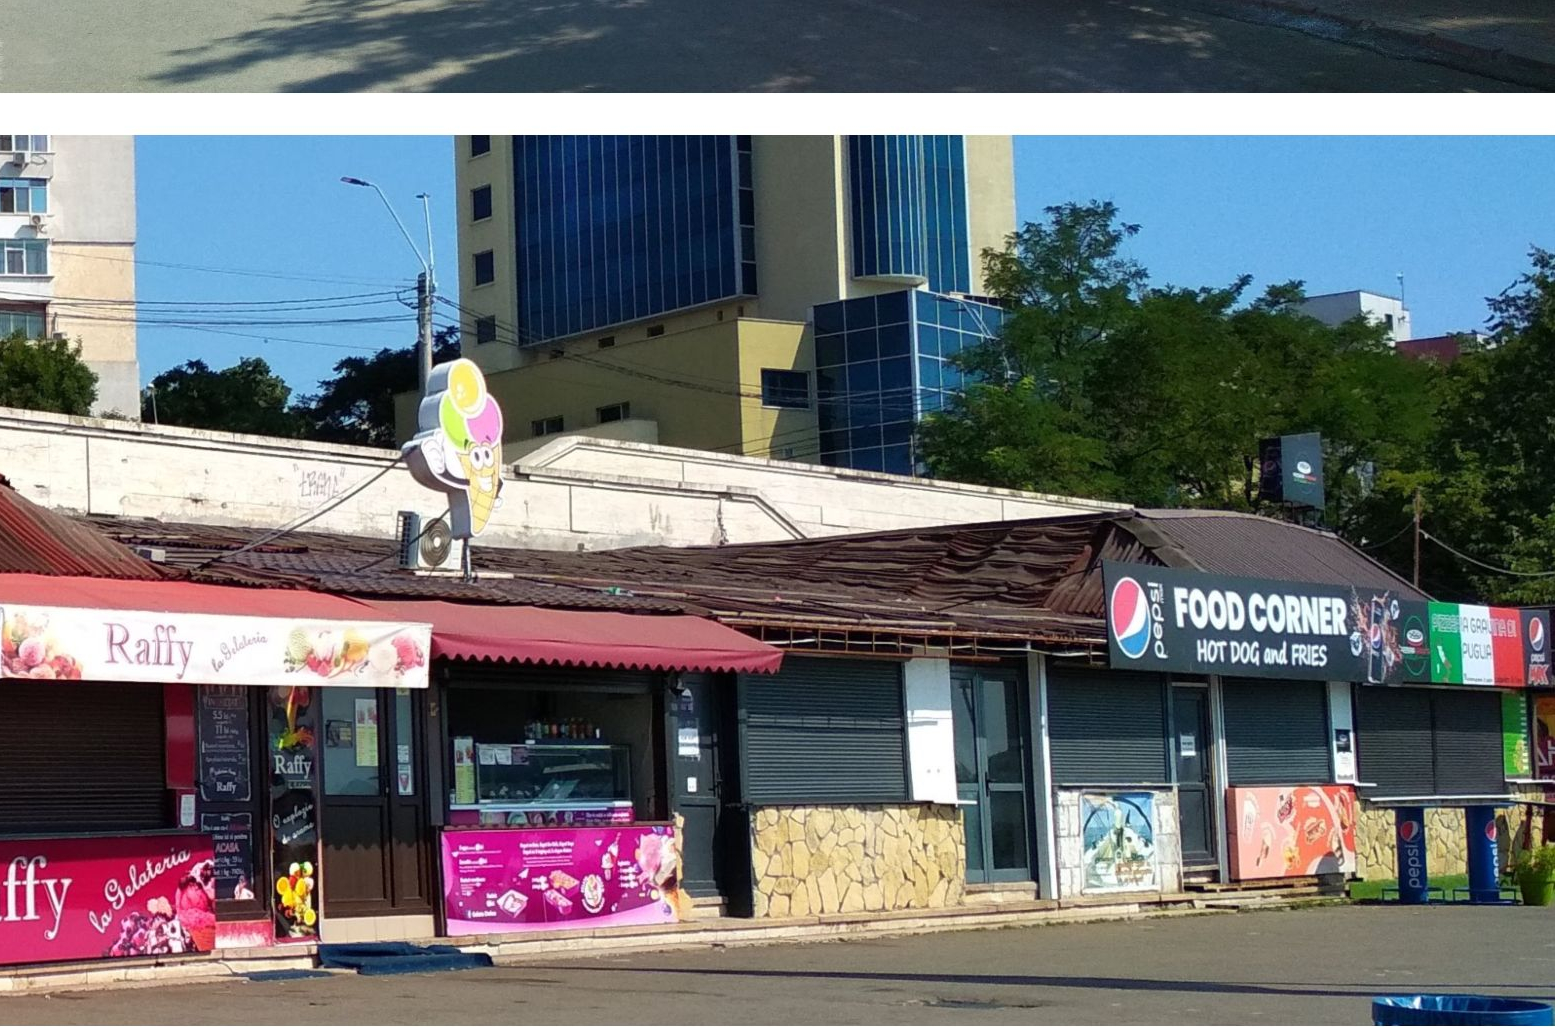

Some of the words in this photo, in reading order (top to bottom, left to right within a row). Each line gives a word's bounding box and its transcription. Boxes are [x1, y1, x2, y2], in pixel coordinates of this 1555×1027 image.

[1147, 581, 1169, 660] pepsi
[1174, 586, 1246, 631] FOOD
[1248, 592, 1348, 636] CORNER
[102, 622, 194, 680] Raffy
[220, 632, 269, 660] Gelateria
[1197, 639, 1227, 664] HOT
[1230, 641, 1260, 667] DOG
[1264, 641, 1288, 664] and
[1292, 644, 1328, 668] FRIES
[1463, 642, 1492, 661] PUGLIA
[216, 782, 237, 795] Raffy
[274, 754, 312, 780] Raffy
[1405, 843, 1423, 889] pepsi
[88, 909, 114, 935] la
[103, 846, 192, 911] Gelateria
